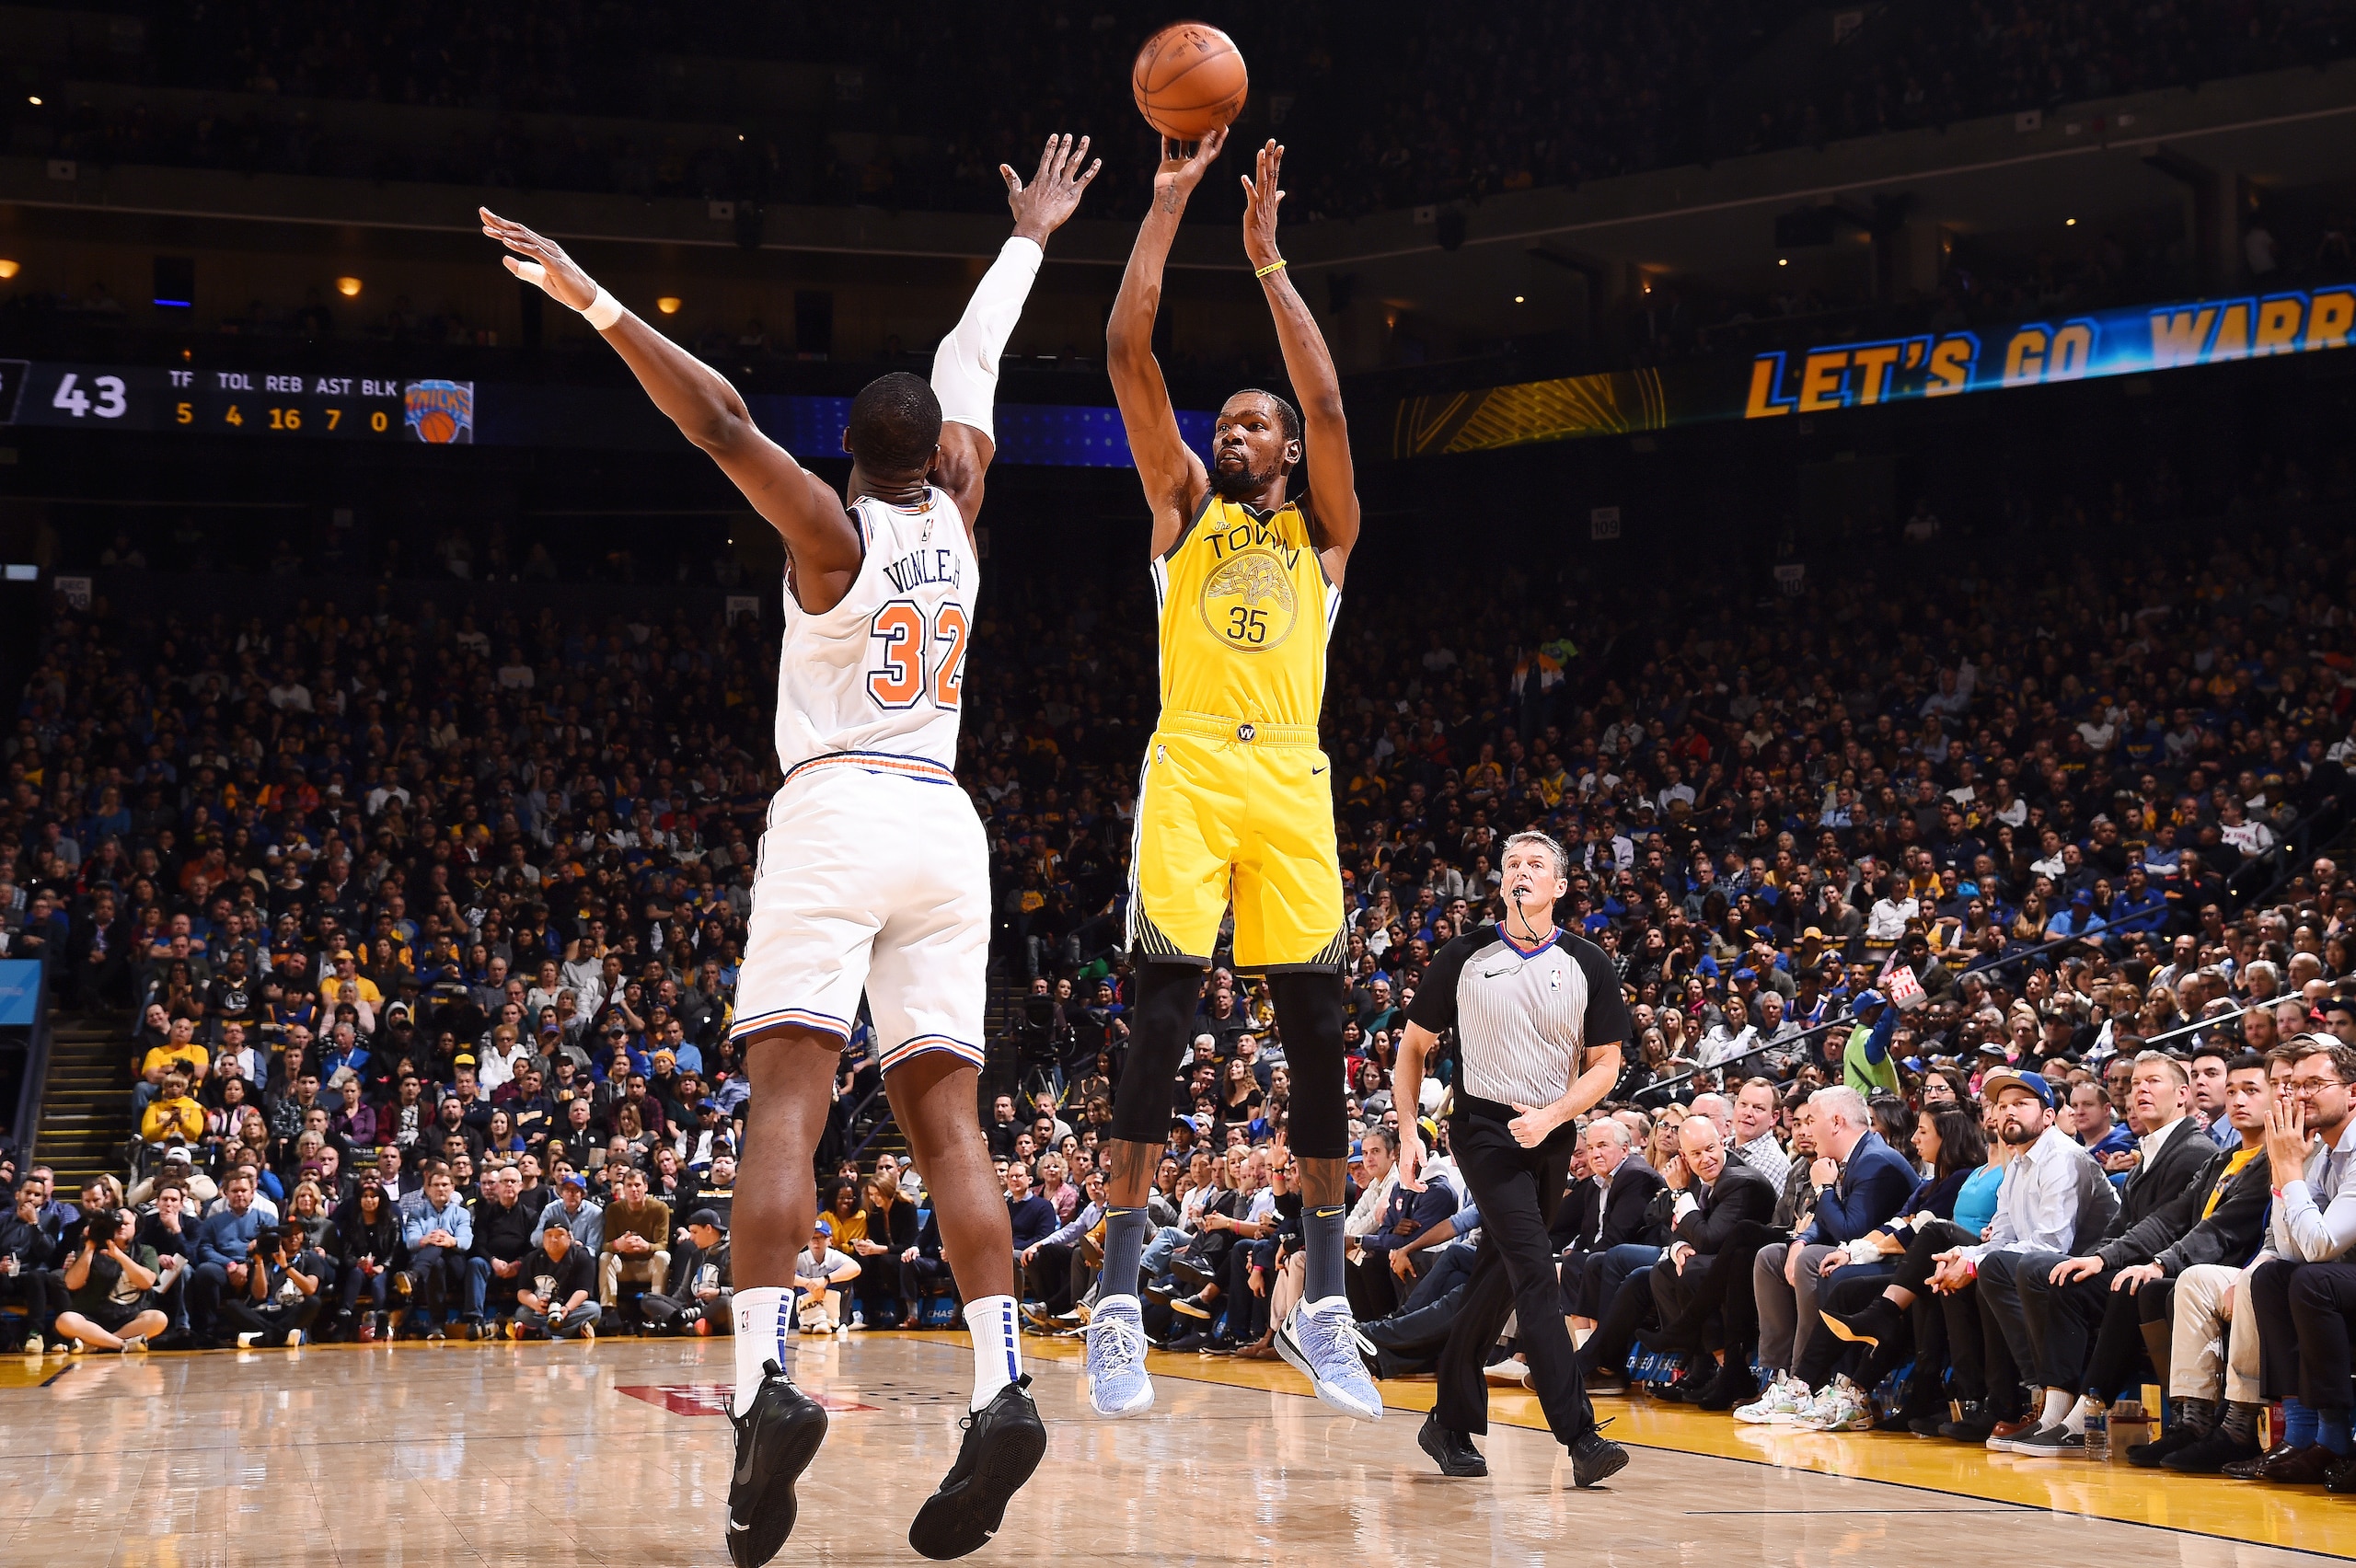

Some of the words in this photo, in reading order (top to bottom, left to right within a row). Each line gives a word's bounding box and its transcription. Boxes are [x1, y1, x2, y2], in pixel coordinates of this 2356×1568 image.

[1745, 334, 1976, 418] LET'S
[2002, 320, 2097, 387] GO
[2148, 287, 2356, 371] WARR
[52, 373, 127, 418] 43
[169, 370, 194, 387] TF
[217, 372, 254, 391] TOL
[265, 375, 303, 393] REB
[316, 378, 352, 396] AST
[362, 379, 397, 397] BLK
[405, 387, 471, 414] KNICKS
[177, 402, 193, 424] 5
[225, 405, 244, 427] 4
[269, 408, 302, 430] 16
[326, 409, 341, 431] 7
[371, 411, 388, 432] 0
[1215, 522, 1231, 531] The
[1595, 520, 1618, 535] 109
[1204, 525, 1300, 571] TOWN
[1227, 606, 1268, 643] 35
[867, 599, 969, 712] 32
[1240, 726, 1254, 740] W
